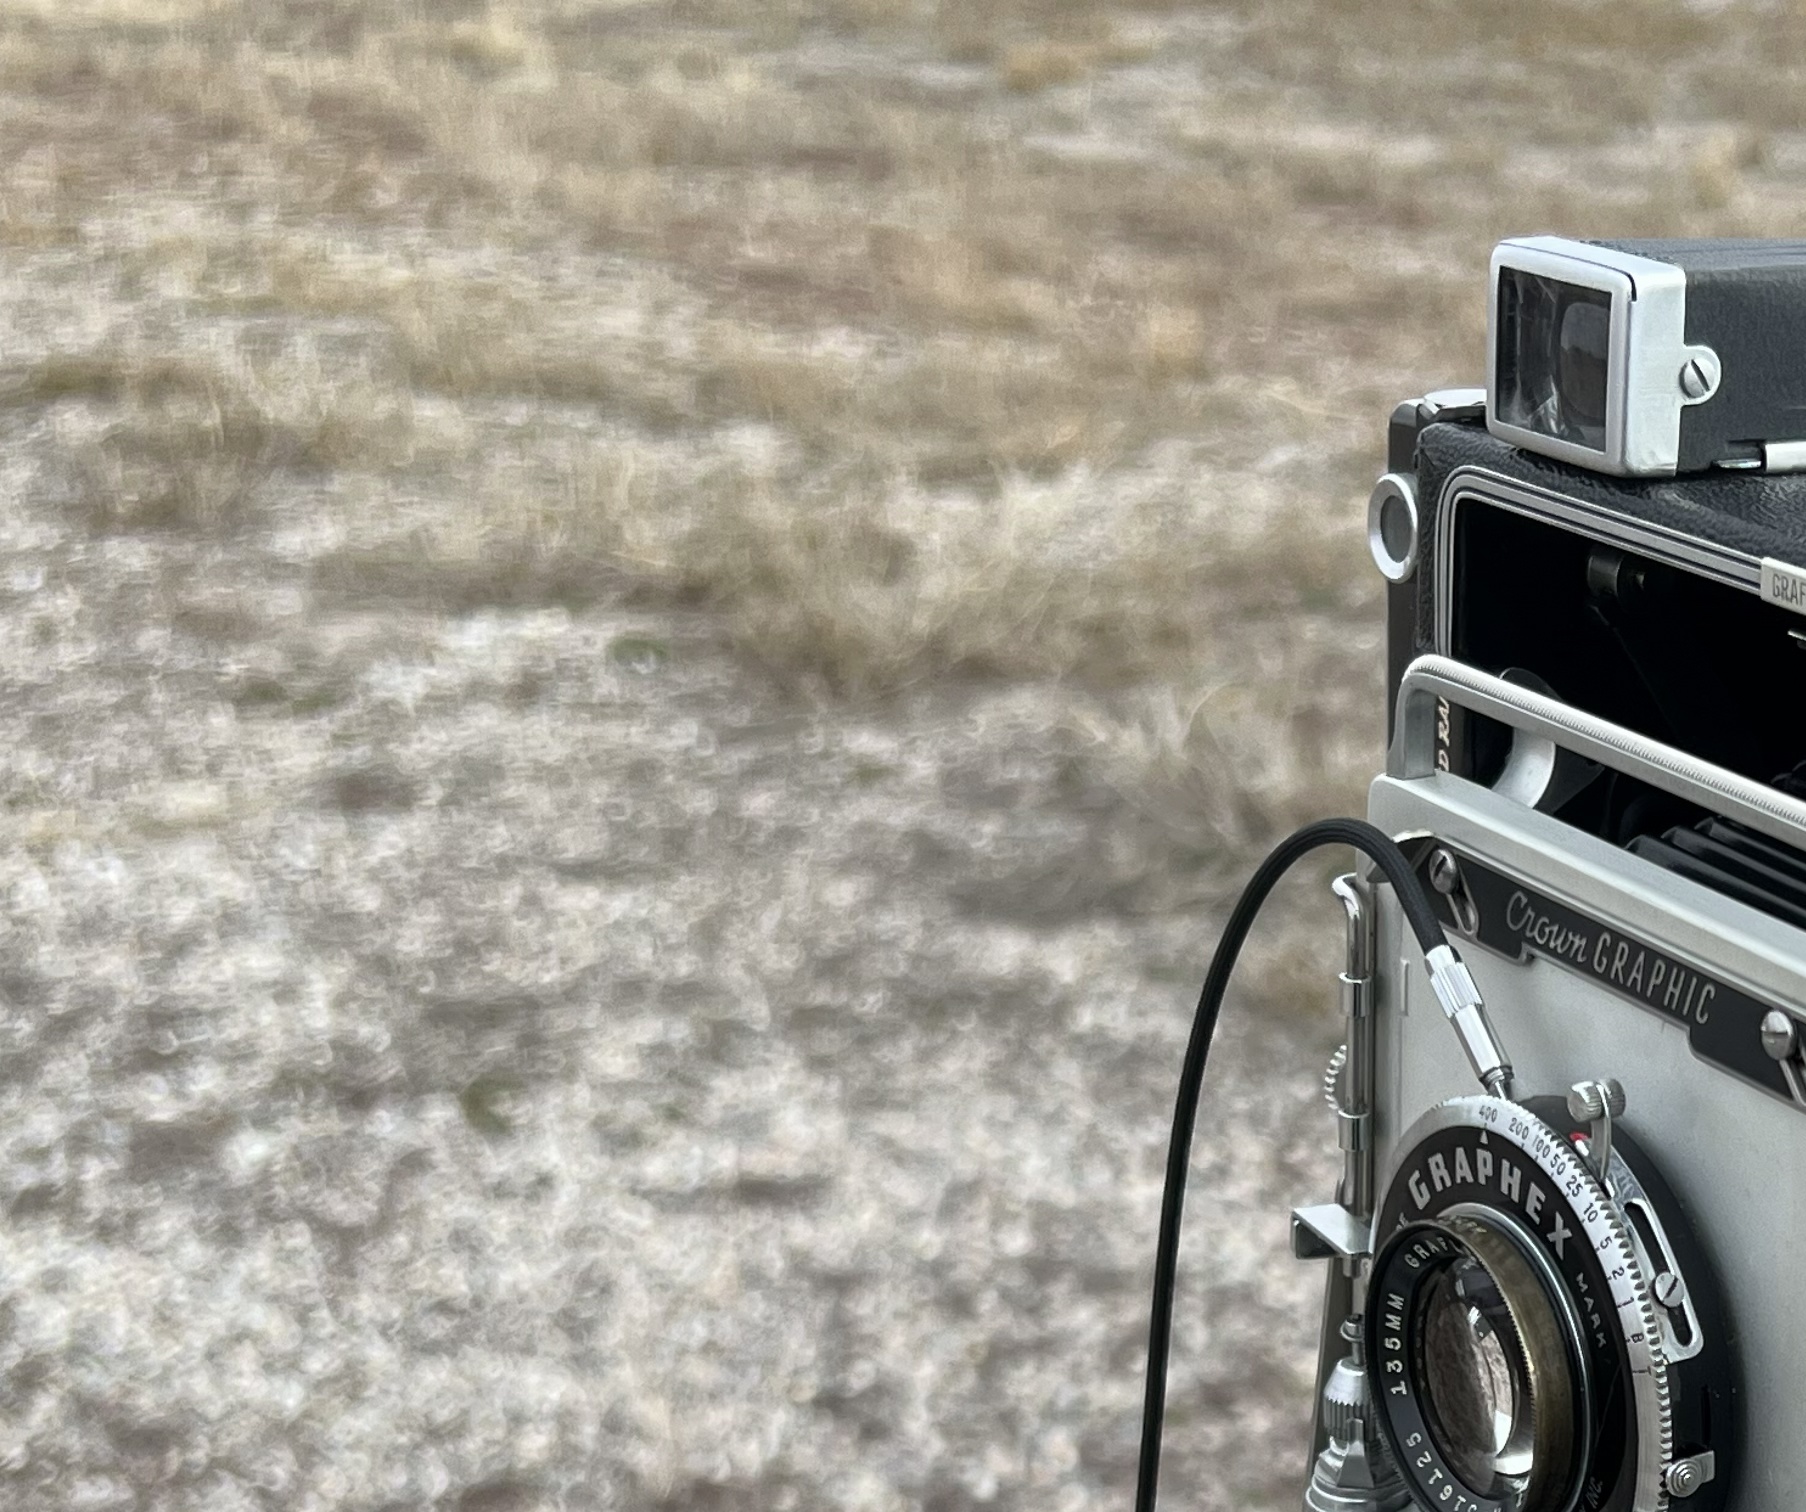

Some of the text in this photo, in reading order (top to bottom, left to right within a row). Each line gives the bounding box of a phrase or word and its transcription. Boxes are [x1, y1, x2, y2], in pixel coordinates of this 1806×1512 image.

[1505, 890, 1716, 1025] Crown GRAPHIC
[1408, 1147, 1573, 1261] GRAPHEX
[1478, 1104, 1498, 1124] 400
[1508, 1117, 1530, 1140] 200
[1531, 1135, 1551, 1159] 100
[1550, 1153, 1567, 1176] 50
[1566, 1175, 1584, 1197] 25
[1583, 1202, 1599, 1223] 10
[1600, 1235, 1613, 1250] 5
[1611, 1266, 1625, 1280] 2
[1630, 1332, 1645, 1344] B
